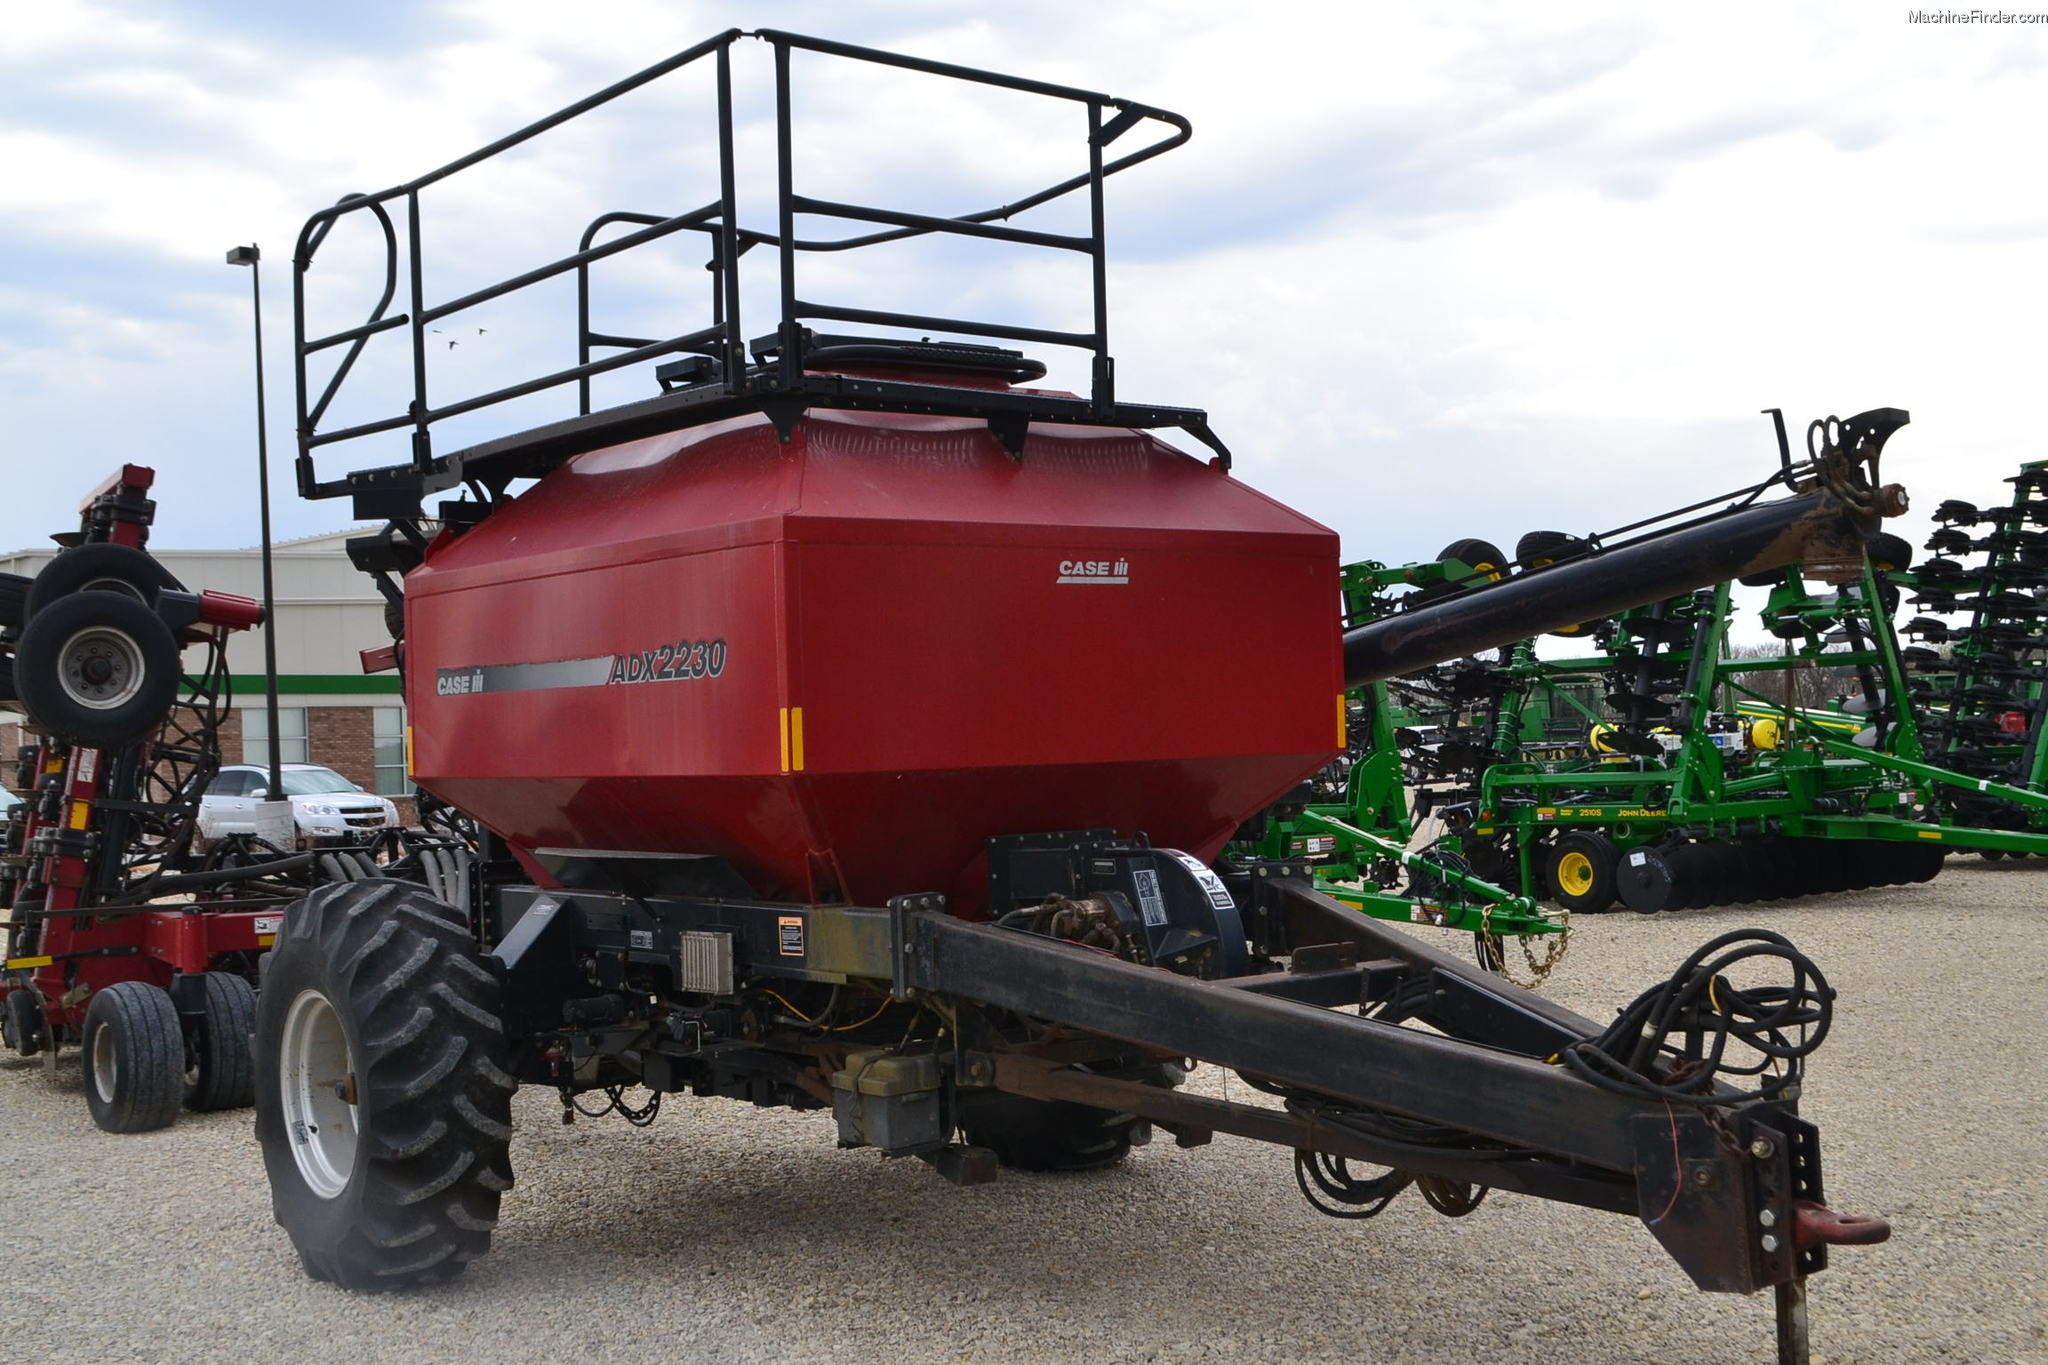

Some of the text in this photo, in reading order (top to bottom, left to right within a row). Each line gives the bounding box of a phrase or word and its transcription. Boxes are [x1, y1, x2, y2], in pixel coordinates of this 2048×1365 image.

[1059, 560, 1109, 576] CASE
[609, 638, 727, 685] ADX2230
[437, 675, 470, 695] CASE
[1579, 808, 1602, 817] 2510S
[1617, 808, 1640, 817] JOHN
